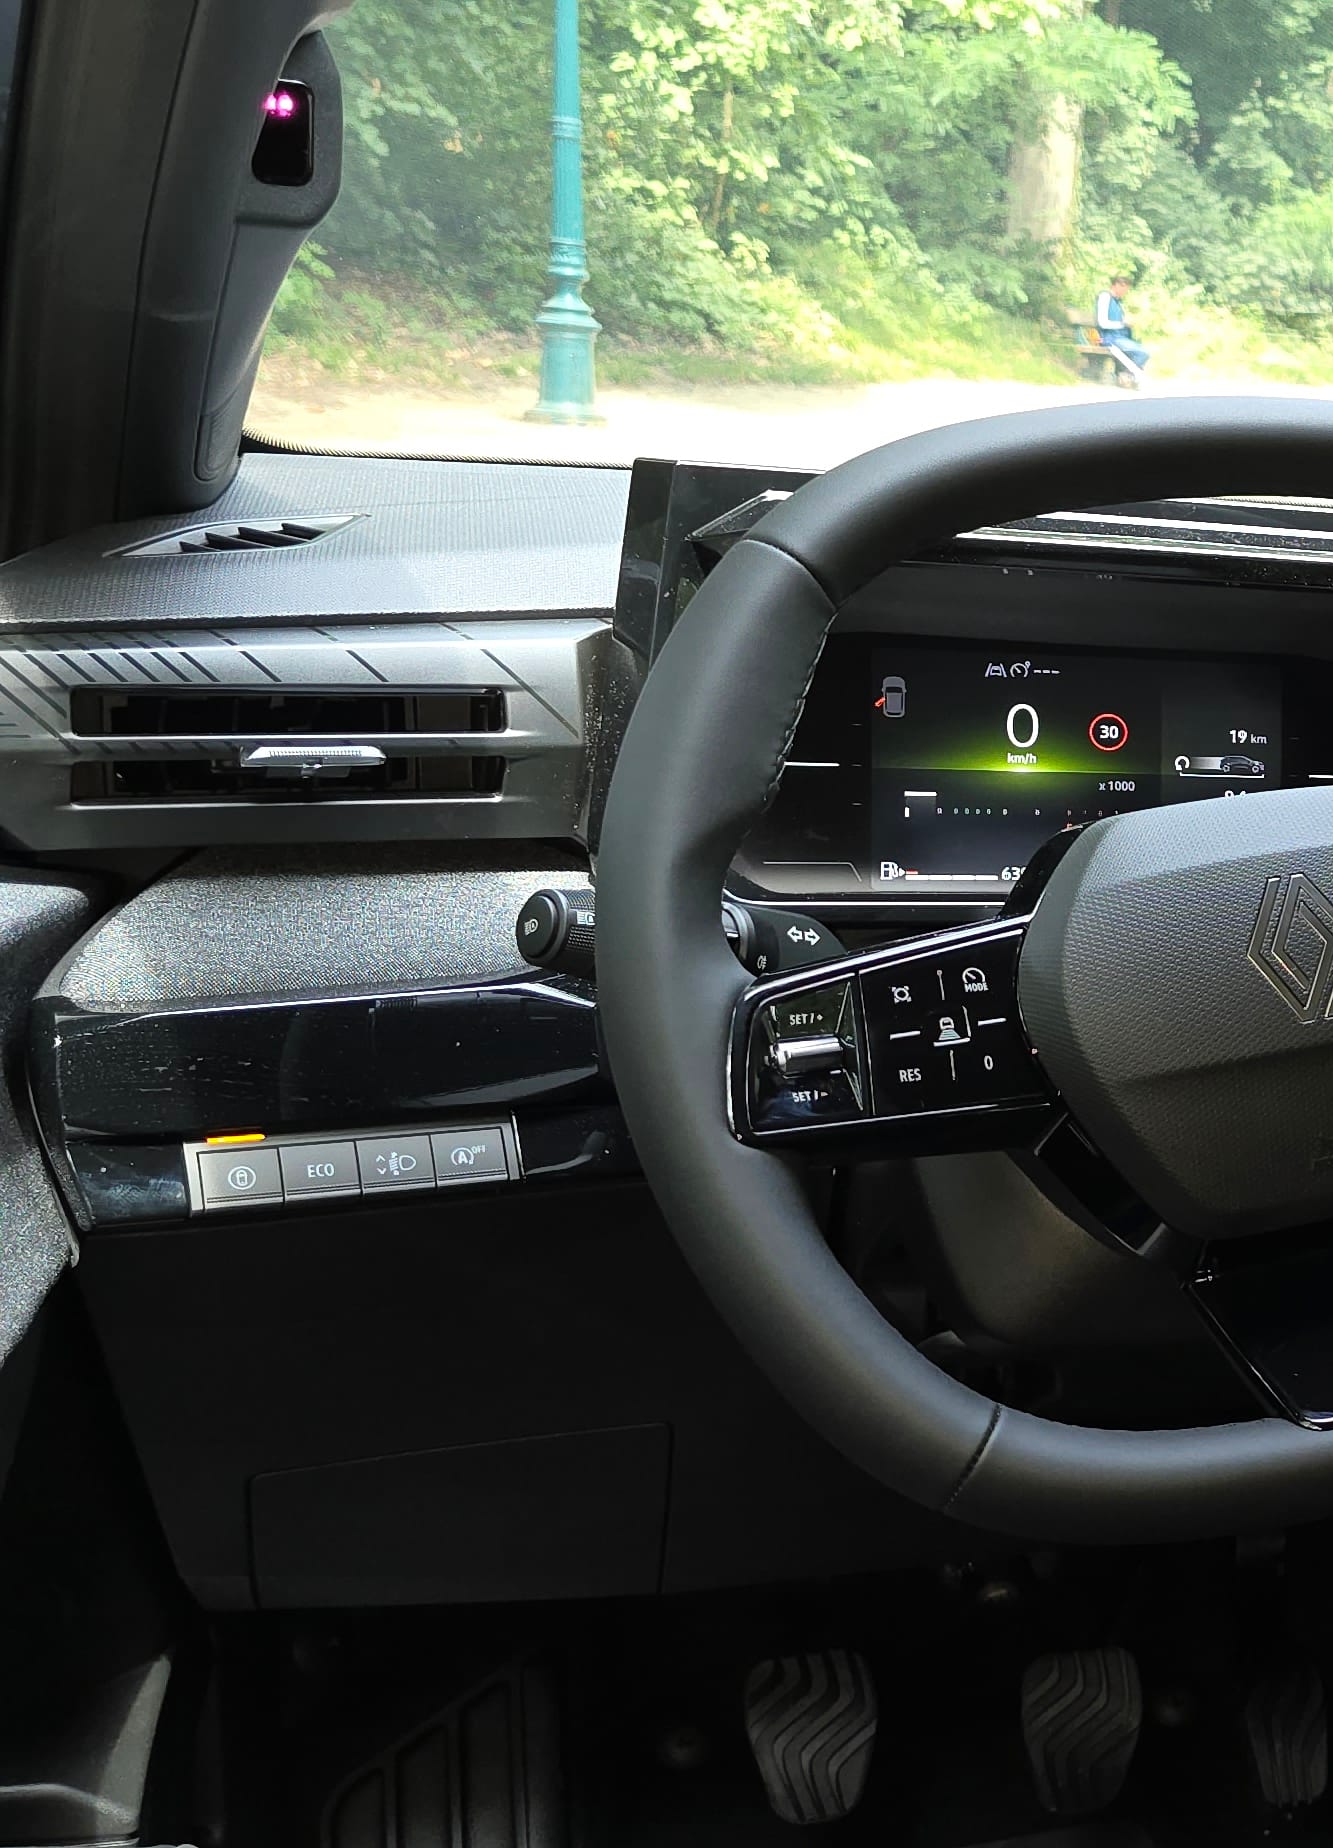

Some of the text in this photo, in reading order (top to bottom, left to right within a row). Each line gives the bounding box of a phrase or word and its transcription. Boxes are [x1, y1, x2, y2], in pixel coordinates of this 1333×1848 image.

[1006, 703, 1040, 748] 0
[1099, 725, 1120, 740] 30
[1229, 729, 1268, 745] 19 km
[1007, 751, 1038, 765] km/h
[1108, 780, 1136, 792] 1000
[964, 982, 989, 993] MODE
[983, 1056, 994, 1070] 0
[899, 1068, 922, 1083] RES
[472, 1144, 486, 1154] OFF
[307, 1164, 335, 1178] ECO
